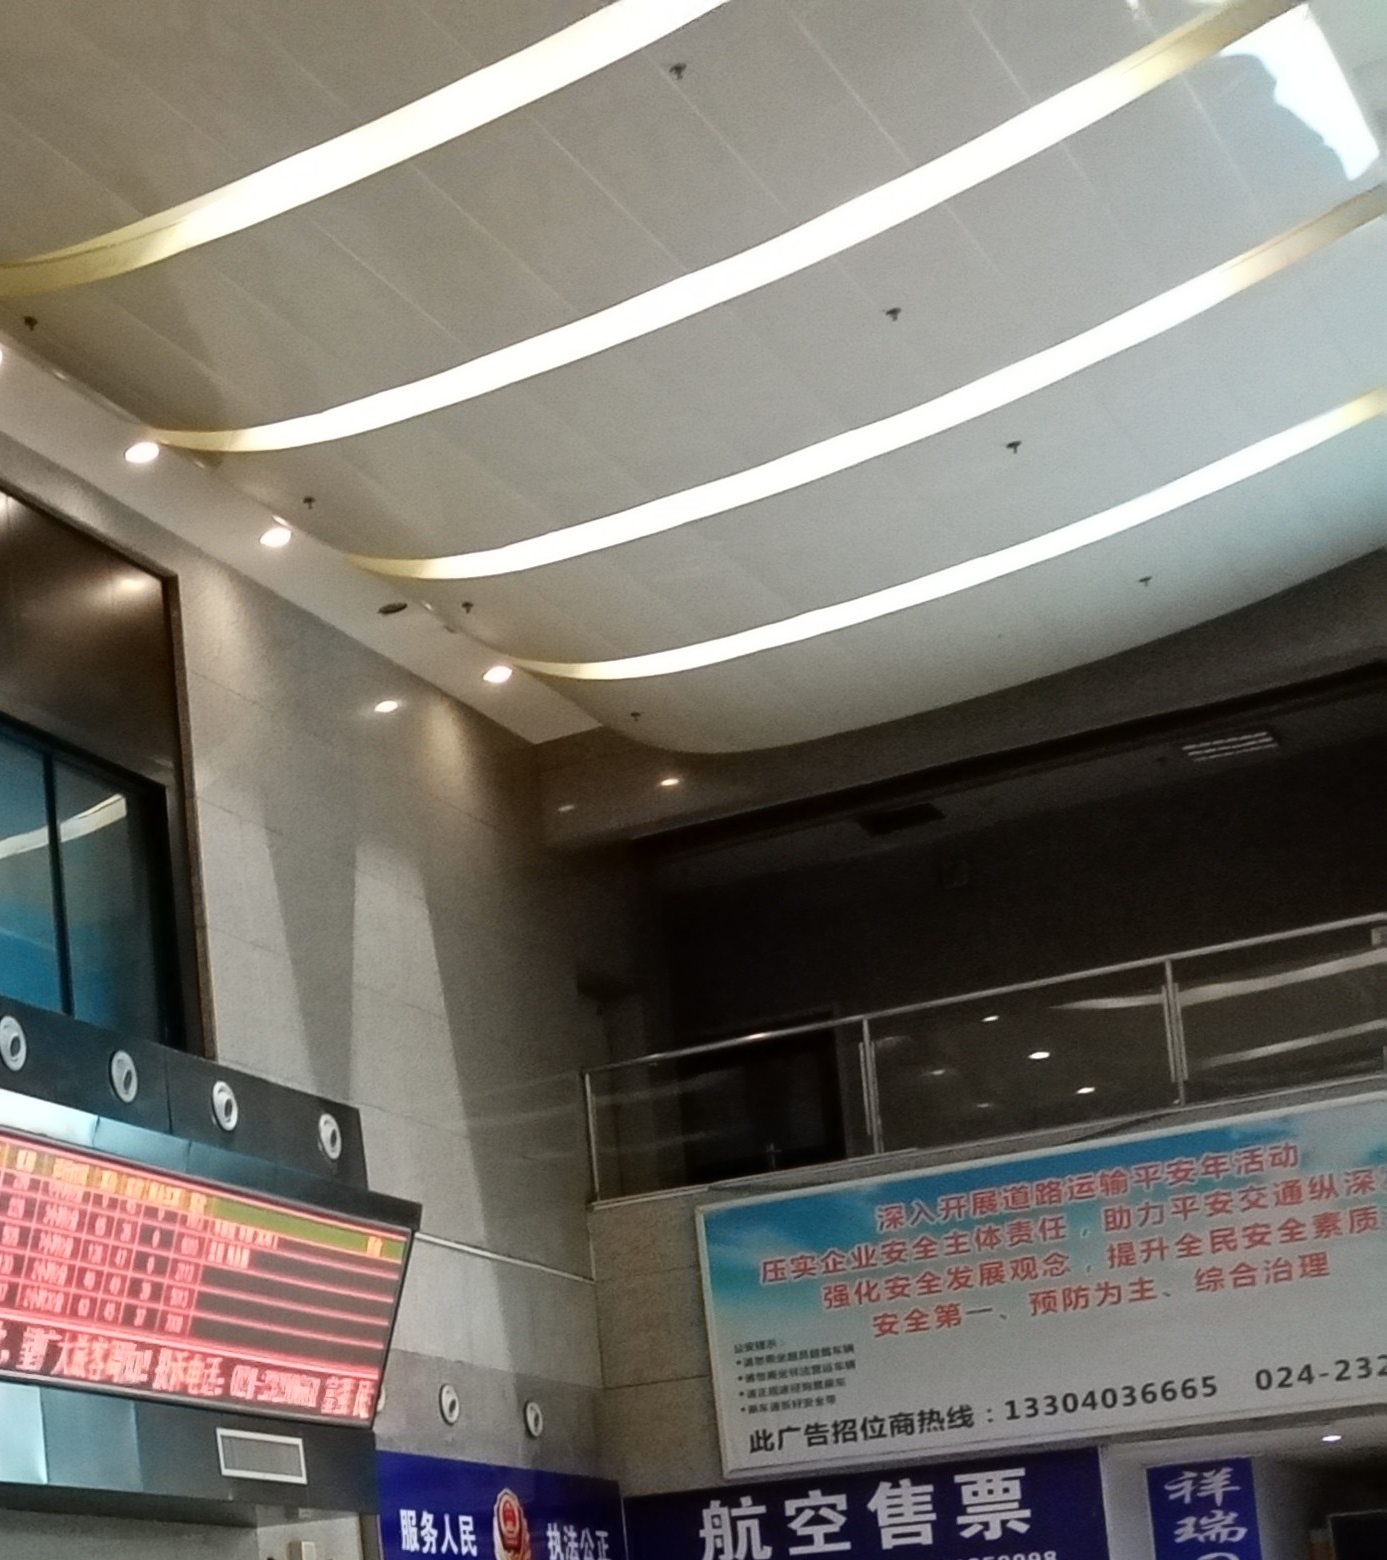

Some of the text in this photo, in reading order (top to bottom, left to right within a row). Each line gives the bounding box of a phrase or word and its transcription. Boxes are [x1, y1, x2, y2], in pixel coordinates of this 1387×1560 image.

[760, 1165, 1387, 1285] 压实企业安全主体责任，助力平安交通纵深
[875, 1142, 1299, 1232] 深入开展道路运输平安年活动
[399, 1509, 478, 1558] 服务人民
